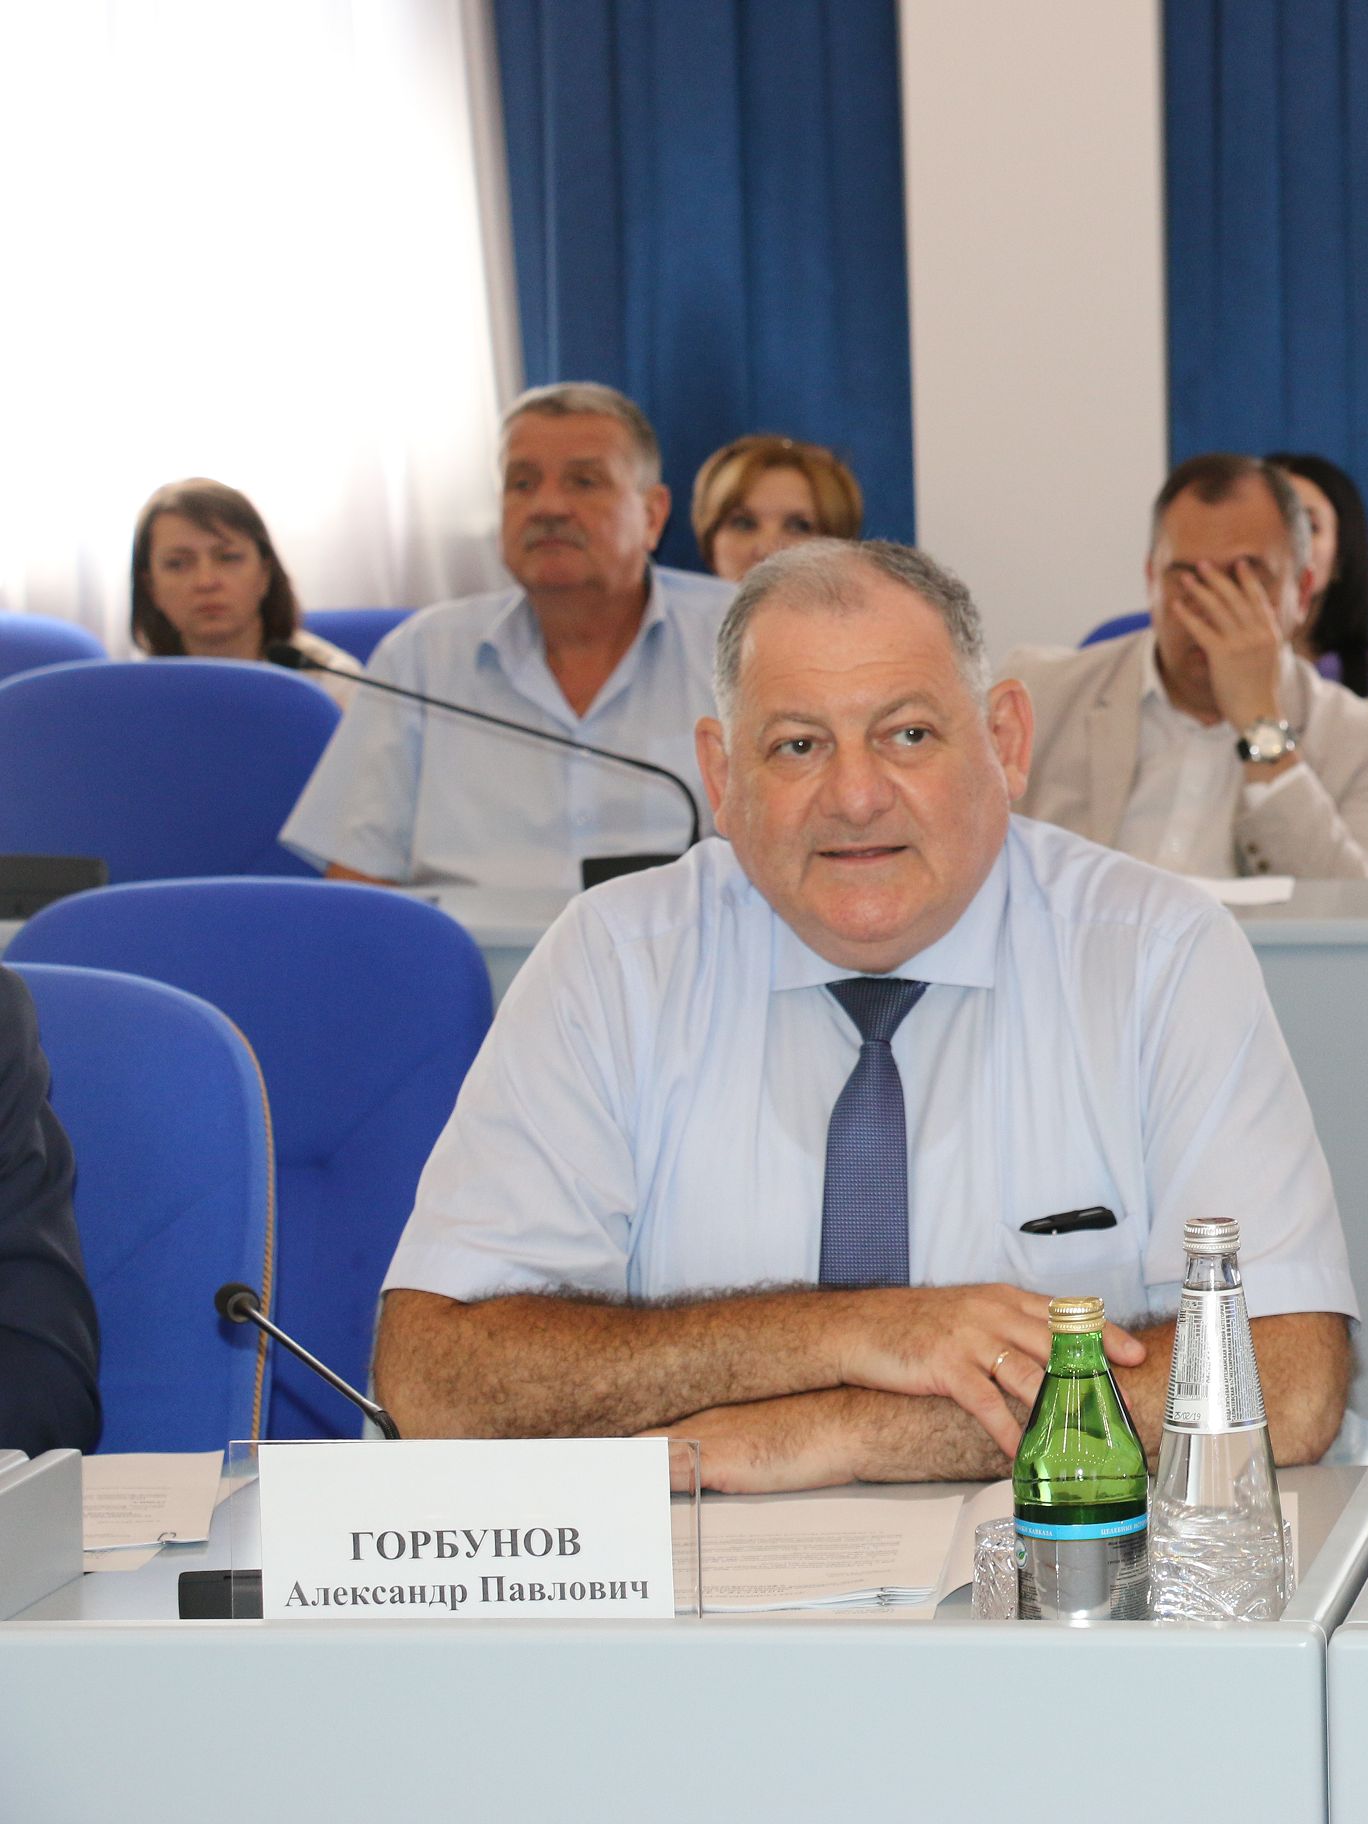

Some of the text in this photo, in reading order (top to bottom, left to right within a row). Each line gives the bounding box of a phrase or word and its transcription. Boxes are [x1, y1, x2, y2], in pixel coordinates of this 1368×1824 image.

[349, 1527, 581, 1560] ГОРБУНОВ
[285, 1575, 649, 1611] Александр Павлович
